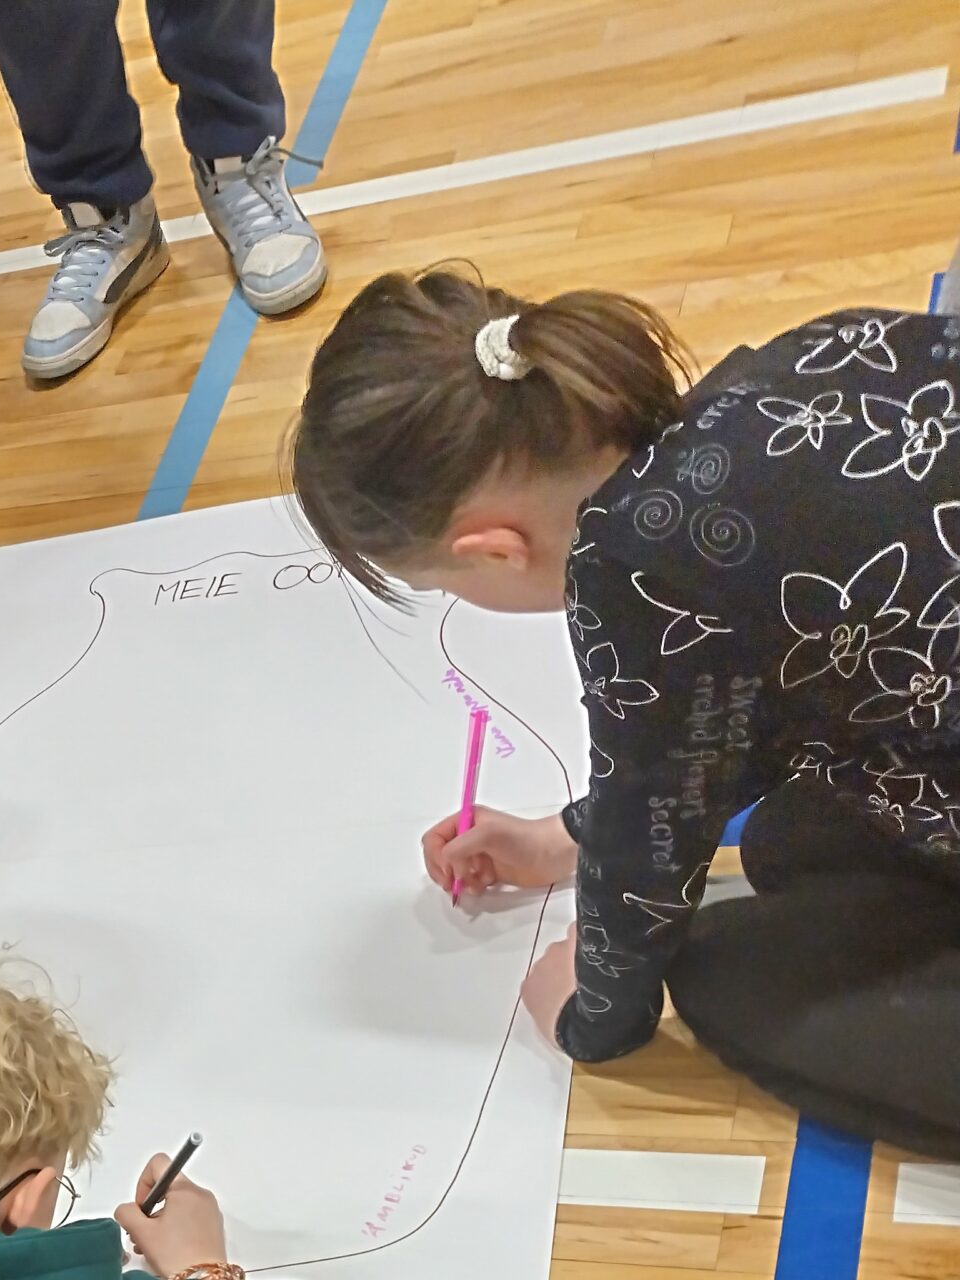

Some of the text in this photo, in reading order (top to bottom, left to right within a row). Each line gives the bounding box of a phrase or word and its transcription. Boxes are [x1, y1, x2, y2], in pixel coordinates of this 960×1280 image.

[154, 561, 342, 605] MEIE OO
[648, 795, 683, 874] Secret
